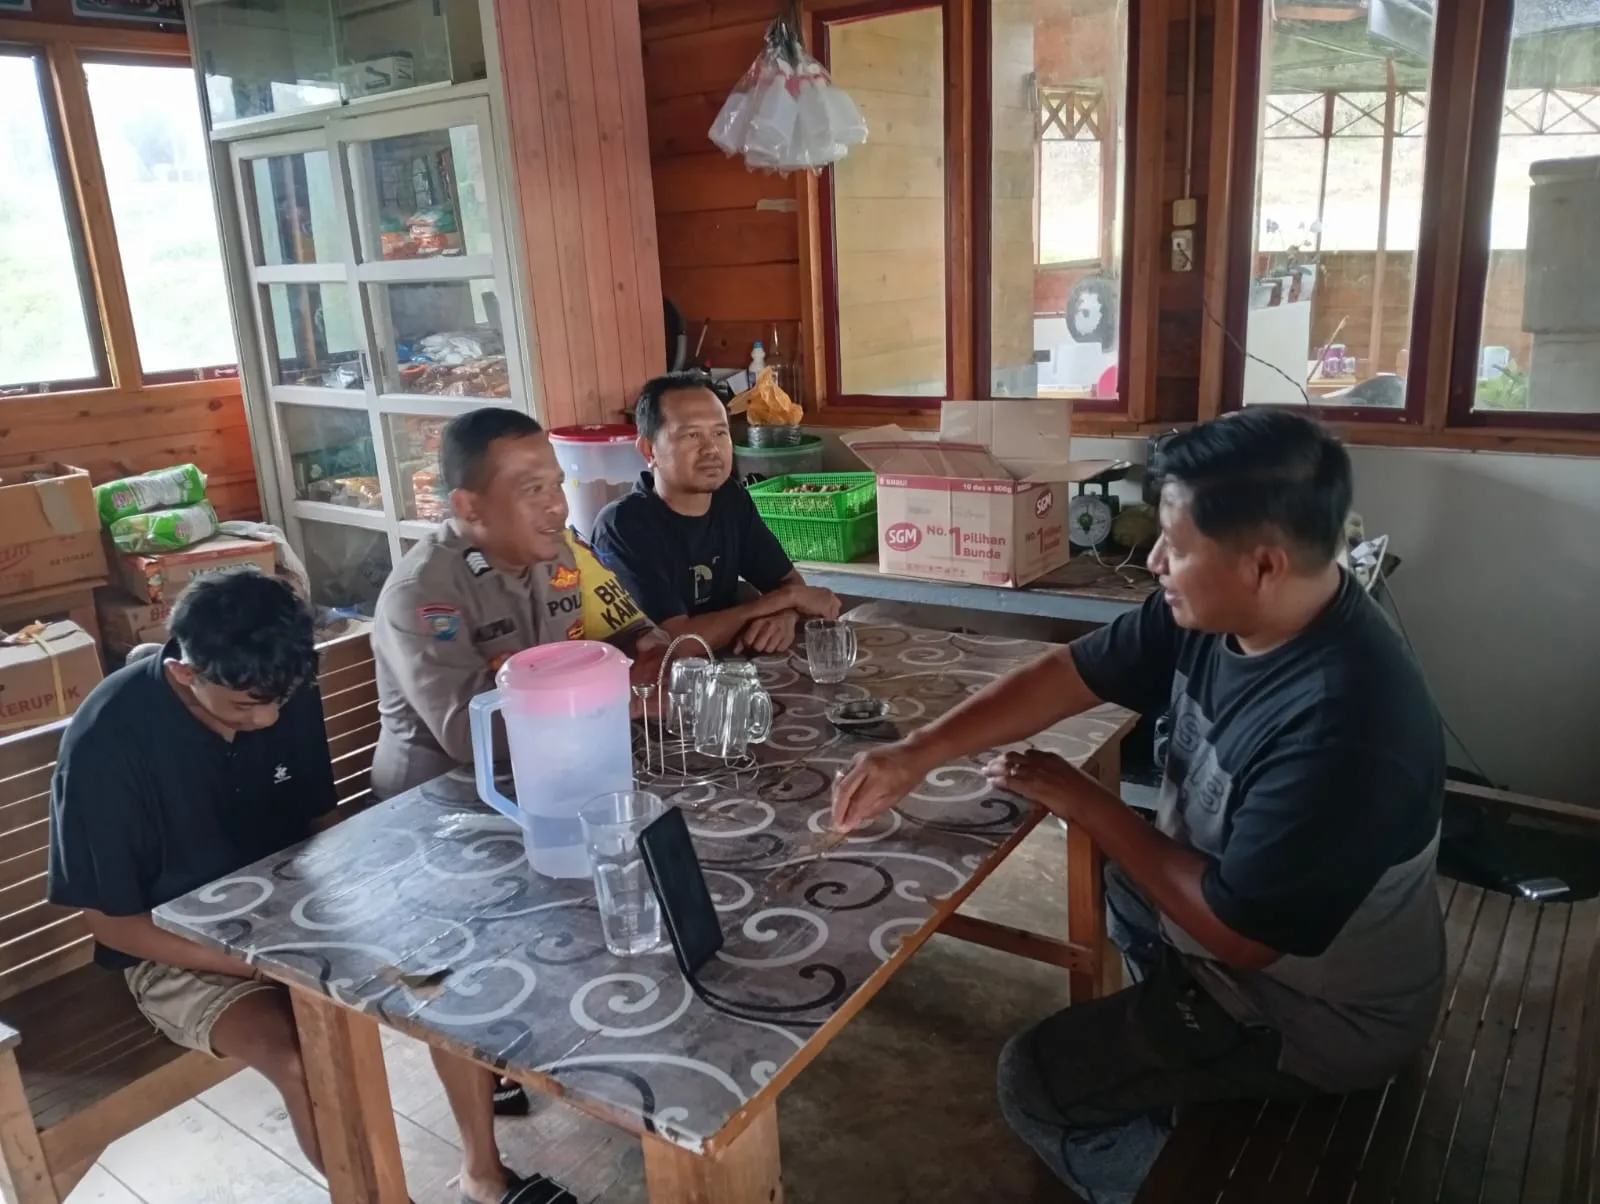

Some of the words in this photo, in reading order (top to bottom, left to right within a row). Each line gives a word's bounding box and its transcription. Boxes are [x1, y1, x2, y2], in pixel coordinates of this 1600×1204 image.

[889, 528, 917, 543] SGM
[926, 524, 947, 536] No.
[949, 527, 961, 556] 1
[963, 533, 1006, 545] Pilihan
[963, 547, 1001, 560] Bunda
[593, 576, 627, 606] BH
